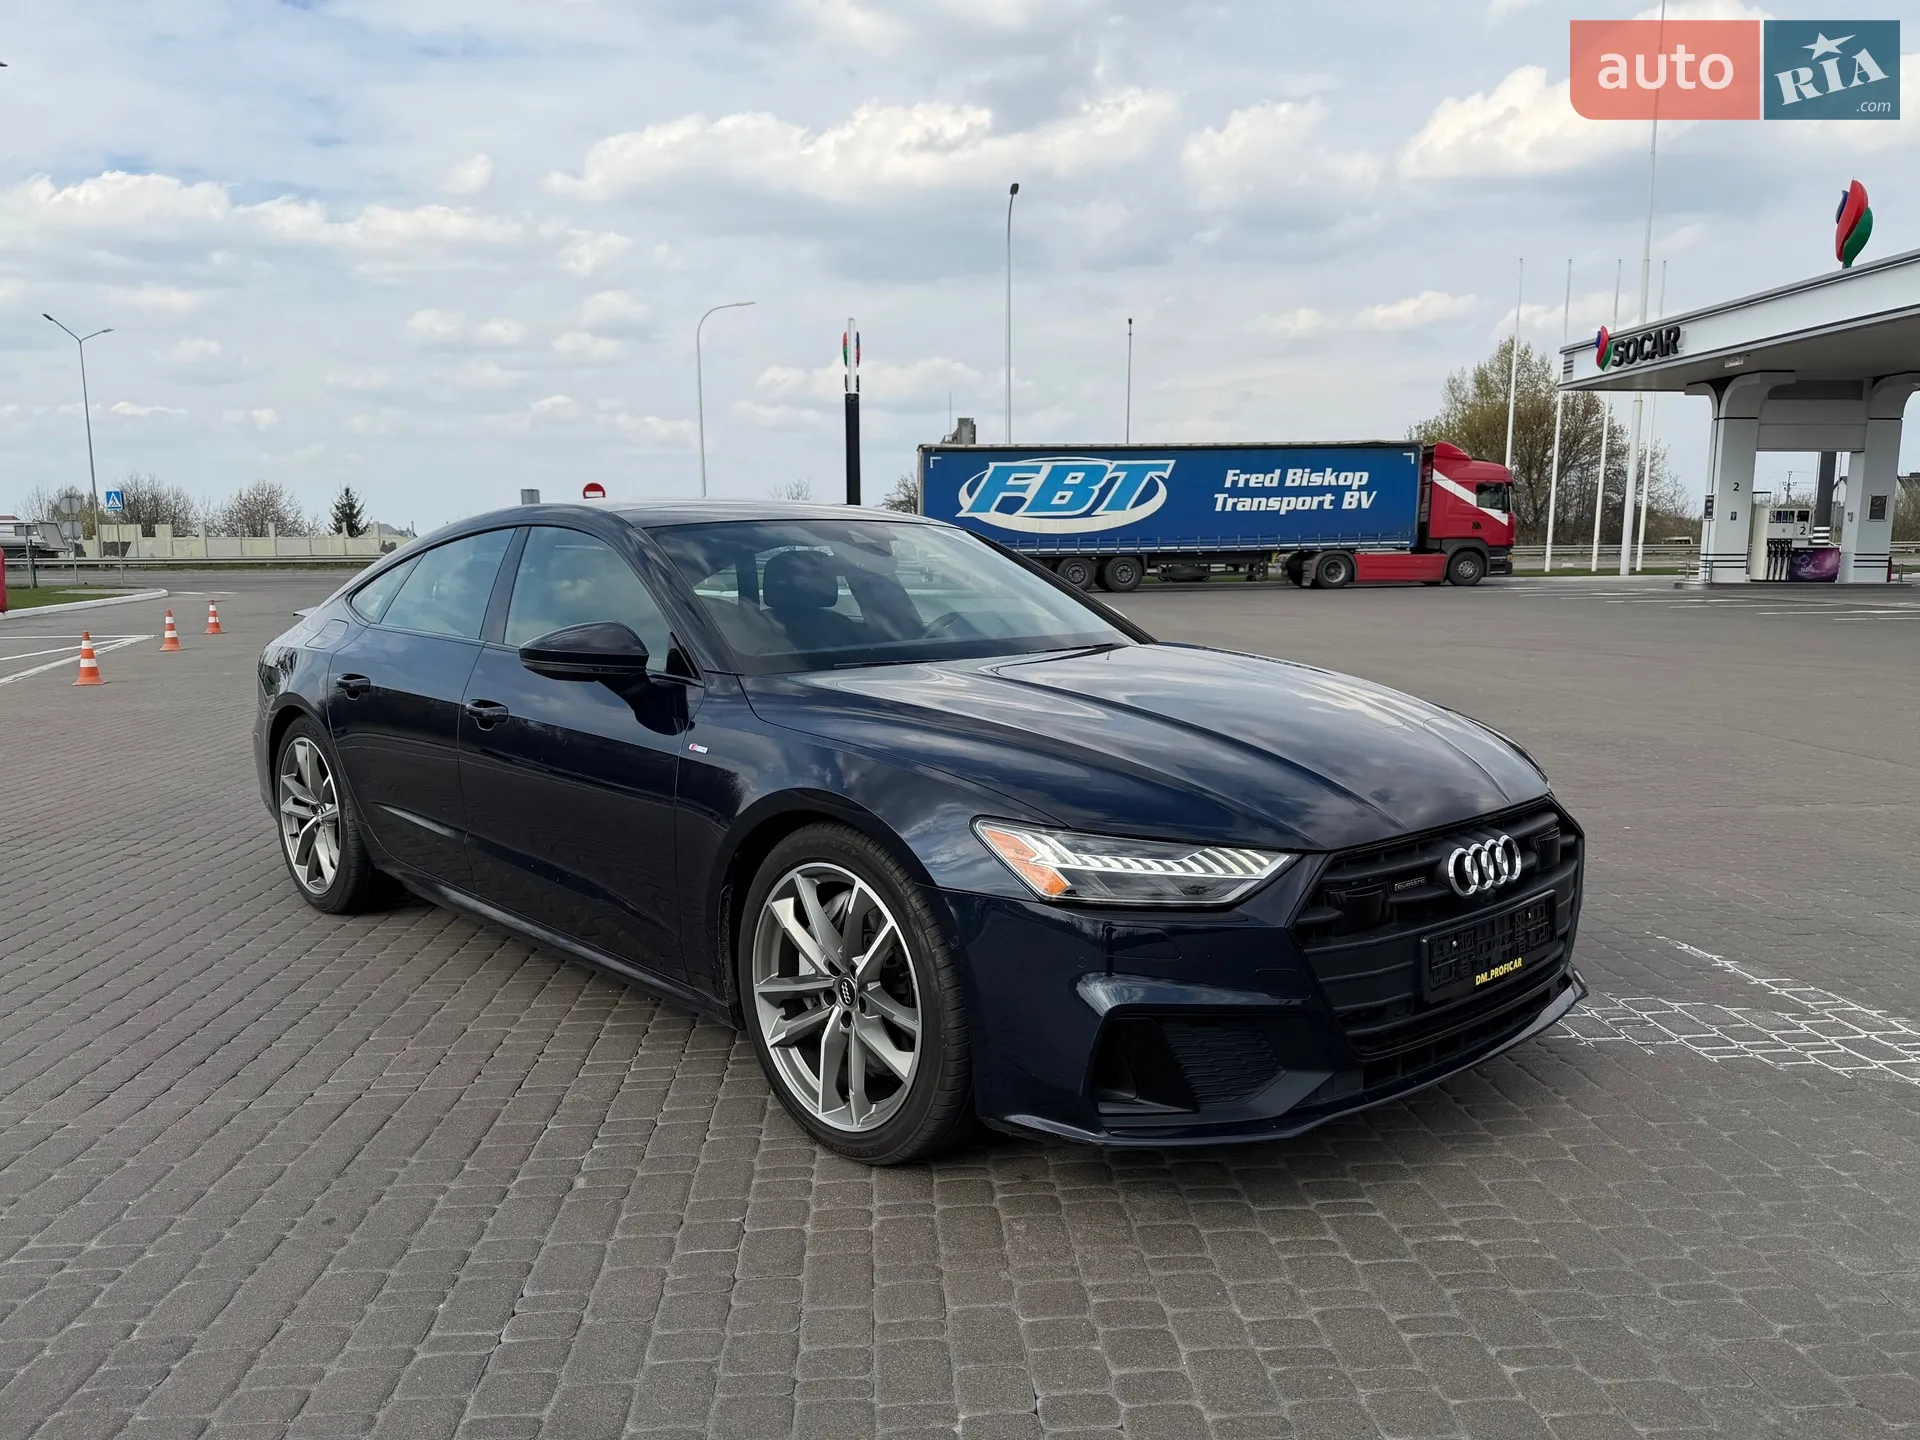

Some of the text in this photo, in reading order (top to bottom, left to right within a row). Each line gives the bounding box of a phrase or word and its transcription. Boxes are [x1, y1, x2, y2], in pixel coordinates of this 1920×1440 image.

[1611, 325, 1681, 367] SOCAR
[955, 460, 1176, 517] FBT
[1224, 468, 1369, 490] Fred Biskop
[1732, 482, 1740, 492] 2
[1213, 490, 1378, 515] Transport BV
[1799, 526, 1806, 535] 2
[1475, 957, 1522, 986] DM_PROFICAR
